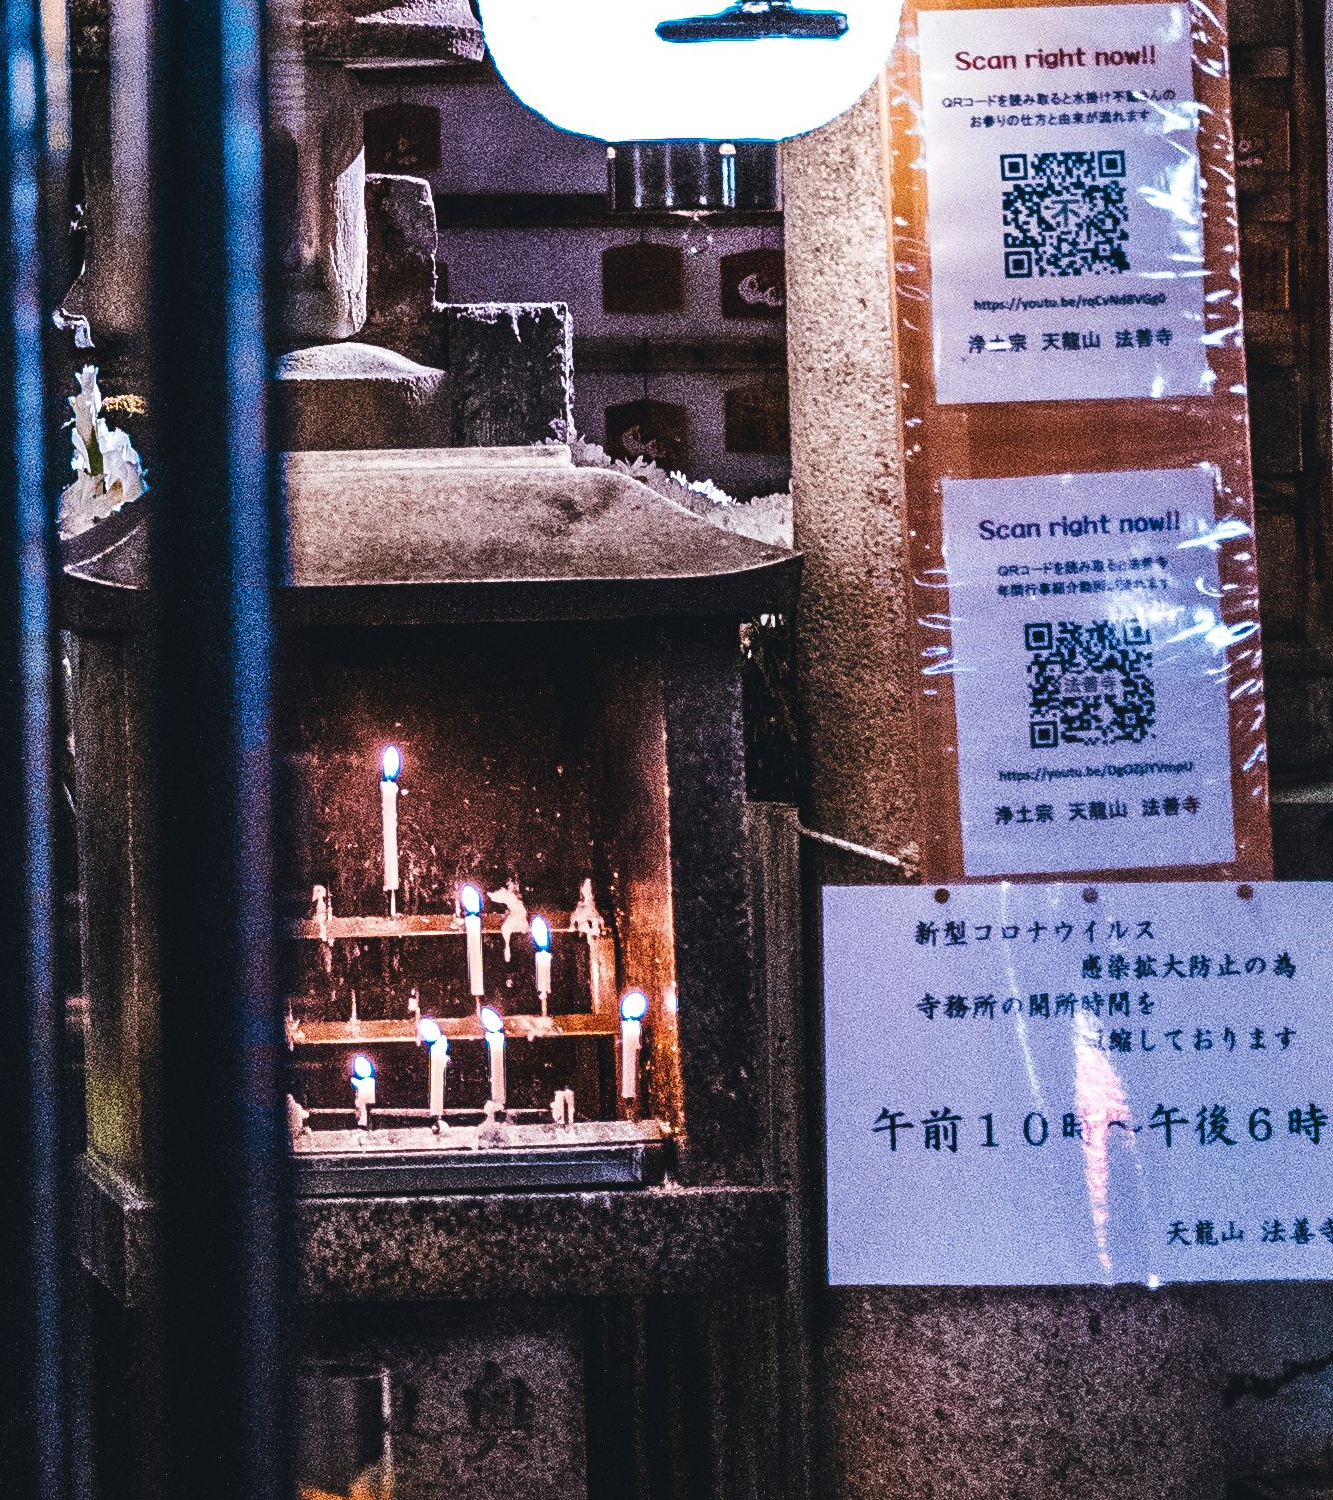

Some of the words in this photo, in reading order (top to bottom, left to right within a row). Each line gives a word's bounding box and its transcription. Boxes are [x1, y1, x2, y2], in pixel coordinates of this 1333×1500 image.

[954, 50, 1018, 72] Scan
[1024, 46, 1087, 70] right
[1094, 44, 1157, 67] now!!
[968, 332, 1028, 355] 浄土宗
[1115, 326, 1173, 349] 法善寺
[978, 518, 1042, 541] Scan
[1049, 514, 1111, 538] right
[1118, 509, 1181, 534] now!!
[994, 803, 1055, 825] 浄土宗
[1141, 795, 1202, 818] 法善寺
[914, 918, 1156, 947] 新型コロナウイルス
[1081, 951, 1298, 980] 感染拡大防止の為
[916, 990, 1155, 1020] 寺務所の開所時間を
